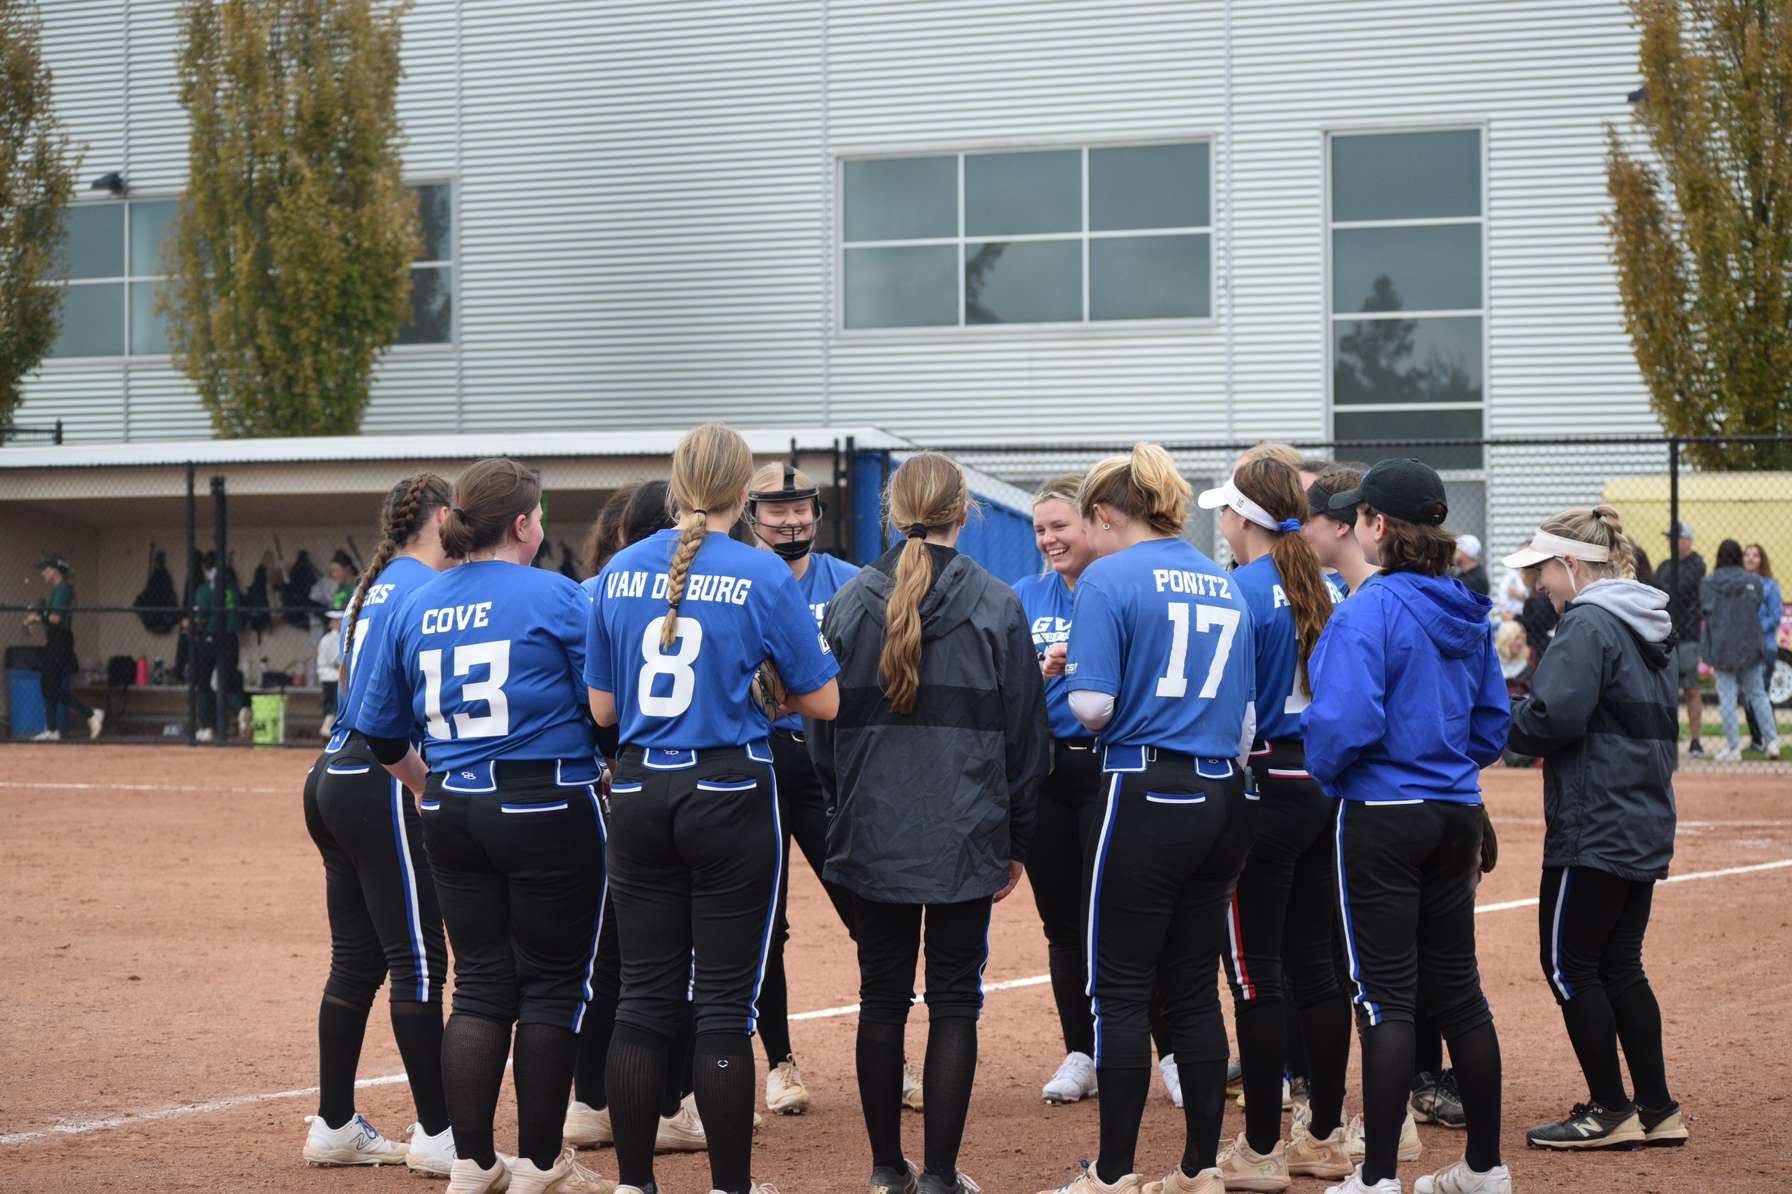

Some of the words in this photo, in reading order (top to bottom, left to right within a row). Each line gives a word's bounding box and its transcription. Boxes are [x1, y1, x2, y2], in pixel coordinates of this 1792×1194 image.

[607, 571, 648, 599] VAN
[651, 573, 672, 600] D
[686, 574, 752, 606] BURG
[1153, 569, 1232, 599] PONITZ
[421, 601, 493, 635] COVE
[1155, 602, 1241, 699] 17
[419, 639, 511, 740] 13
[638, 616, 703, 718] 8
